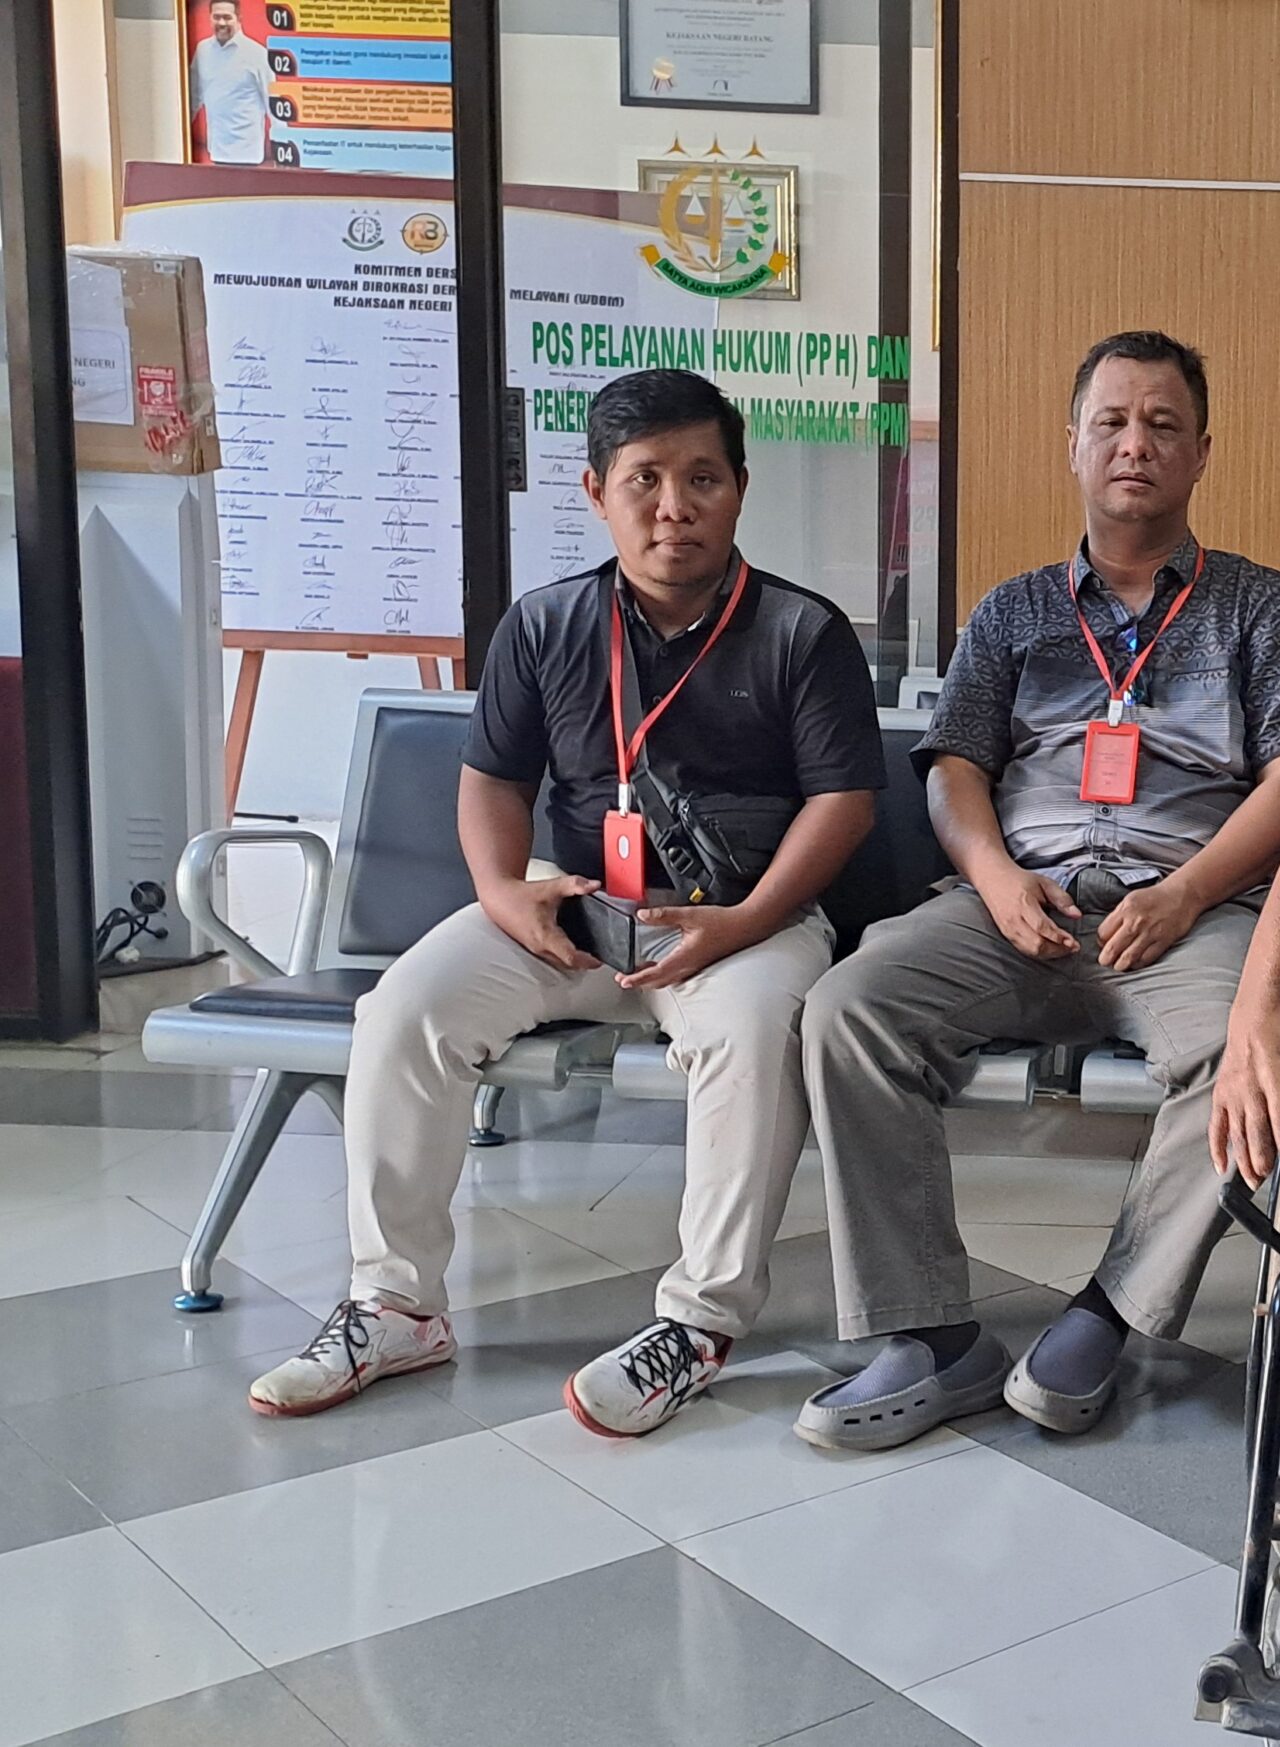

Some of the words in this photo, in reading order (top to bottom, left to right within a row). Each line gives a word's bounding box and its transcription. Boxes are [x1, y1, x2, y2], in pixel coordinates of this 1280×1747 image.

[273, 10, 288, 27] 01
[274, 56, 290, 72] 02
[276, 101, 292, 117] 03
[277, 147, 293, 163] 04
[354, 264, 422, 278] KOMITMEN
[213, 273, 301, 289] MEWUJUDKAN
[306, 278, 358, 292] WILAYAH
[362, 281, 429, 294] BIROKRASI
[334, 296, 405, 310] KEJAKSAAN
[408, 299, 453, 312] NEGERI
[510, 289, 570, 304] MELAYANI
[532, 321, 574, 366] POS
[581, 323, 705, 371] PELAYANAN
[713, 329, 791, 374] HUKUM
[867, 335, 910, 380] DAN
[74, 358, 115, 369] NEGERI
[751, 398, 859, 443] MASYARAKAT
